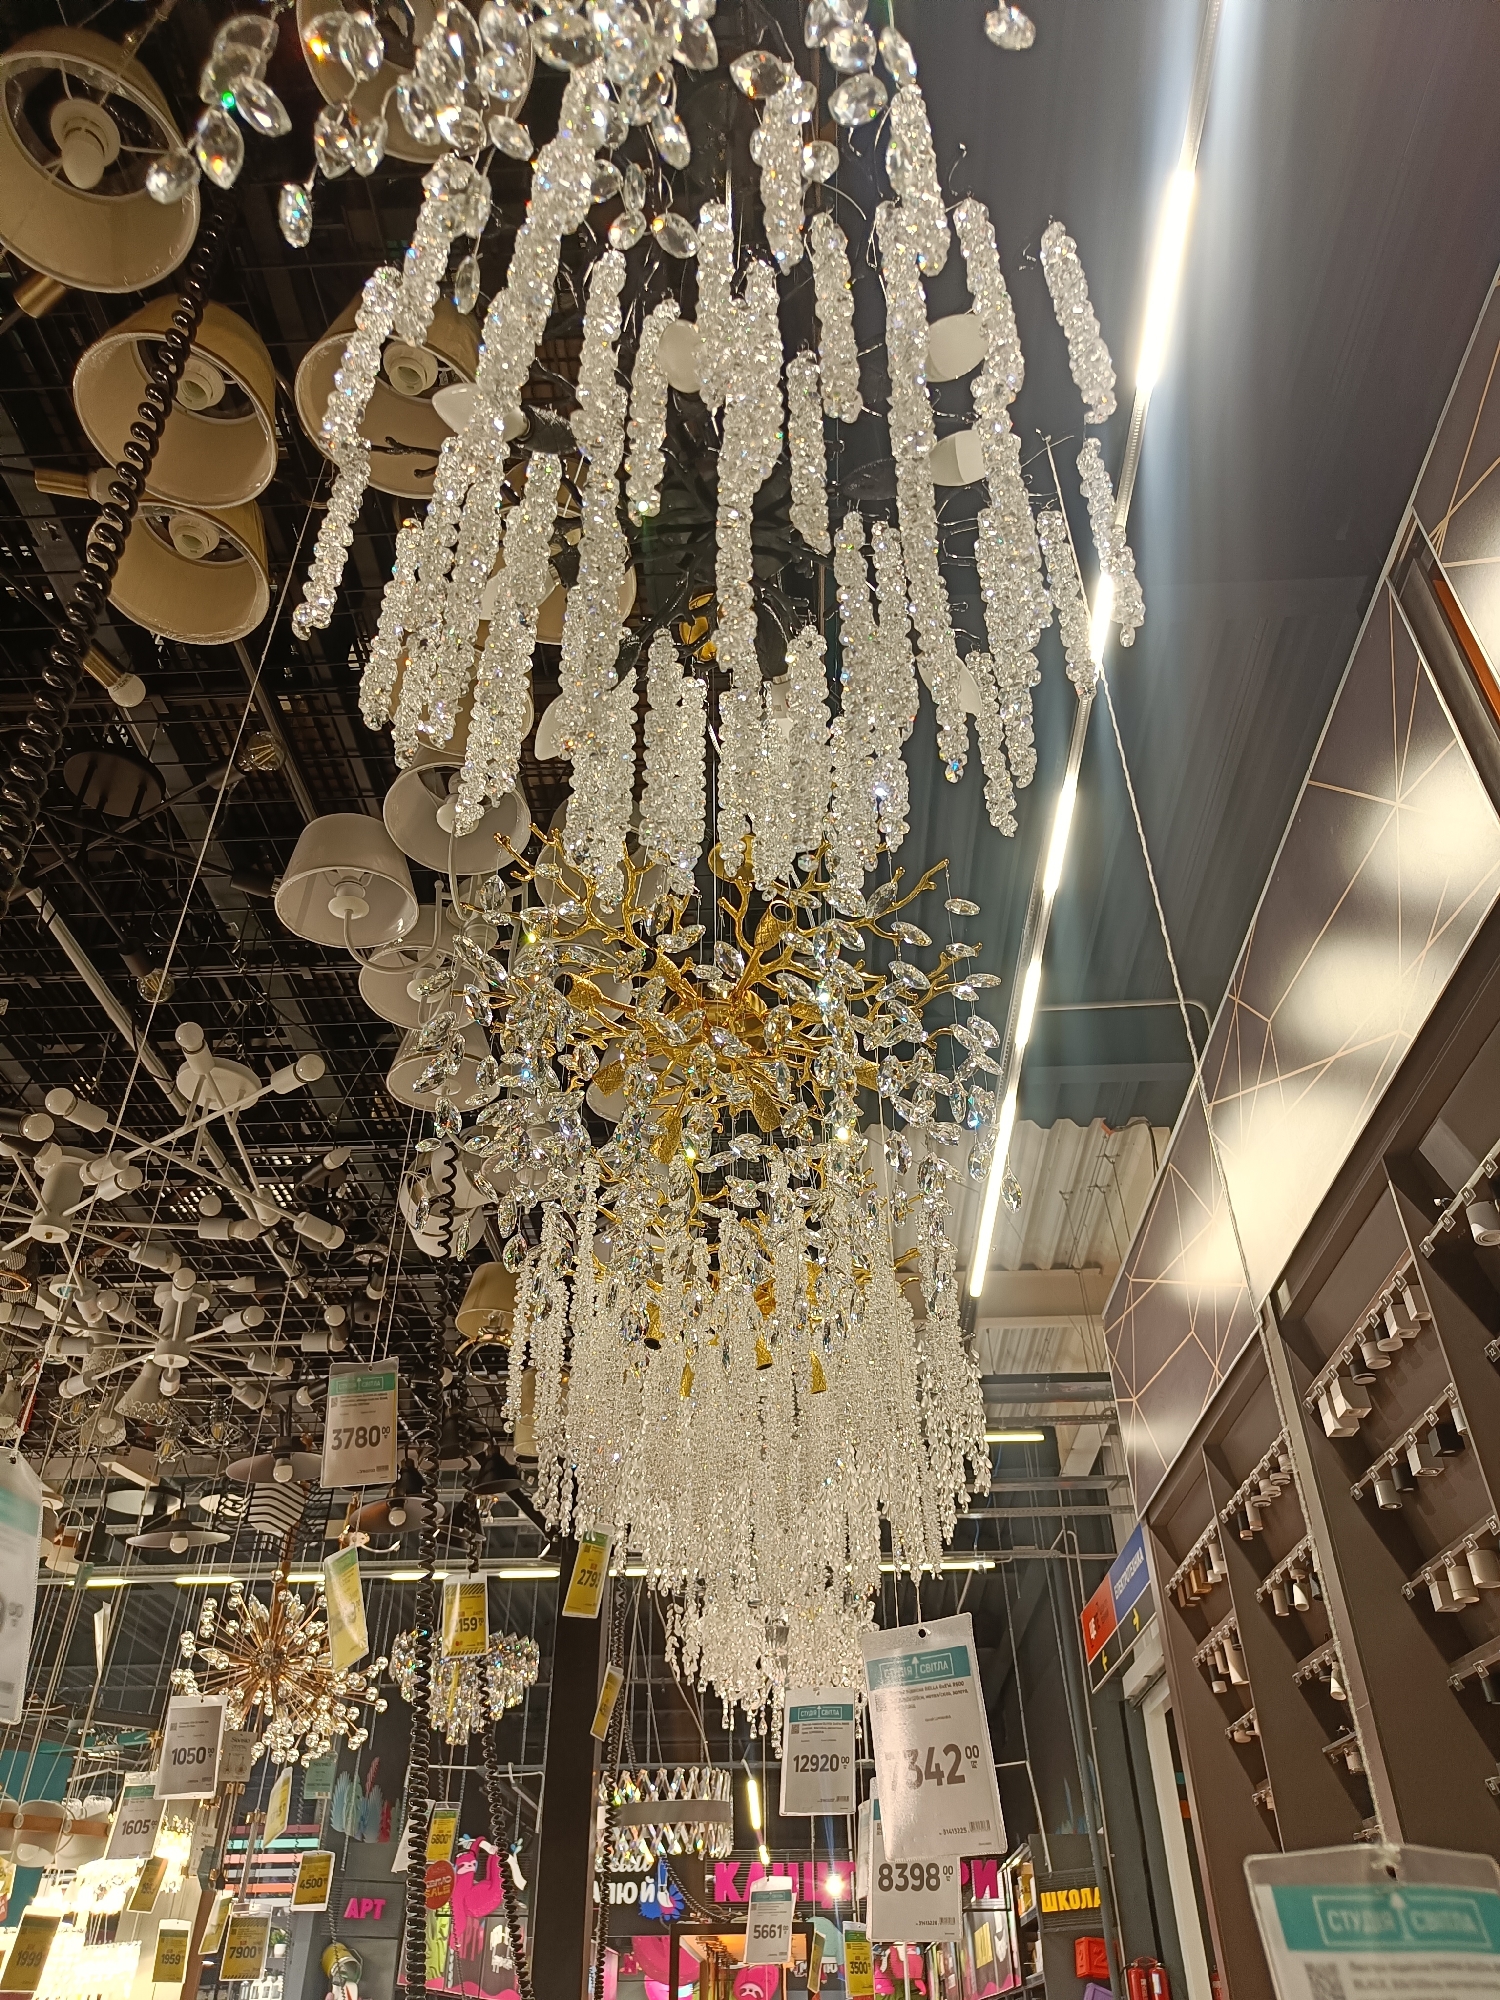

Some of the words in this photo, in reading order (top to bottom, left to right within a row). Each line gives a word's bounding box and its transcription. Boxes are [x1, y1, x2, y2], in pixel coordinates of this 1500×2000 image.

[331, 1425, 381, 1451] 3780
[920, 1660, 949, 1674] СВІТЛА
[171, 1746, 207, 1766] 1050
[793, 1753, 840, 1773] 12920
[885, 1744, 966, 1791] 342
[965, 1745, 979, 1759] 00
[121, 1819, 150, 1836] 1605
[299, 1877, 323, 1890] 4500
[878, 1862, 941, 1892] 8398
[943, 1865, 954, 1875] 00
[425, 1884, 451, 1899] SALE
[344, 1897, 386, 1920] АРТ
[753, 1924, 783, 1940] 5661
[229, 1945, 257, 1959] 7900
[849, 1961, 868, 1975] 3500
